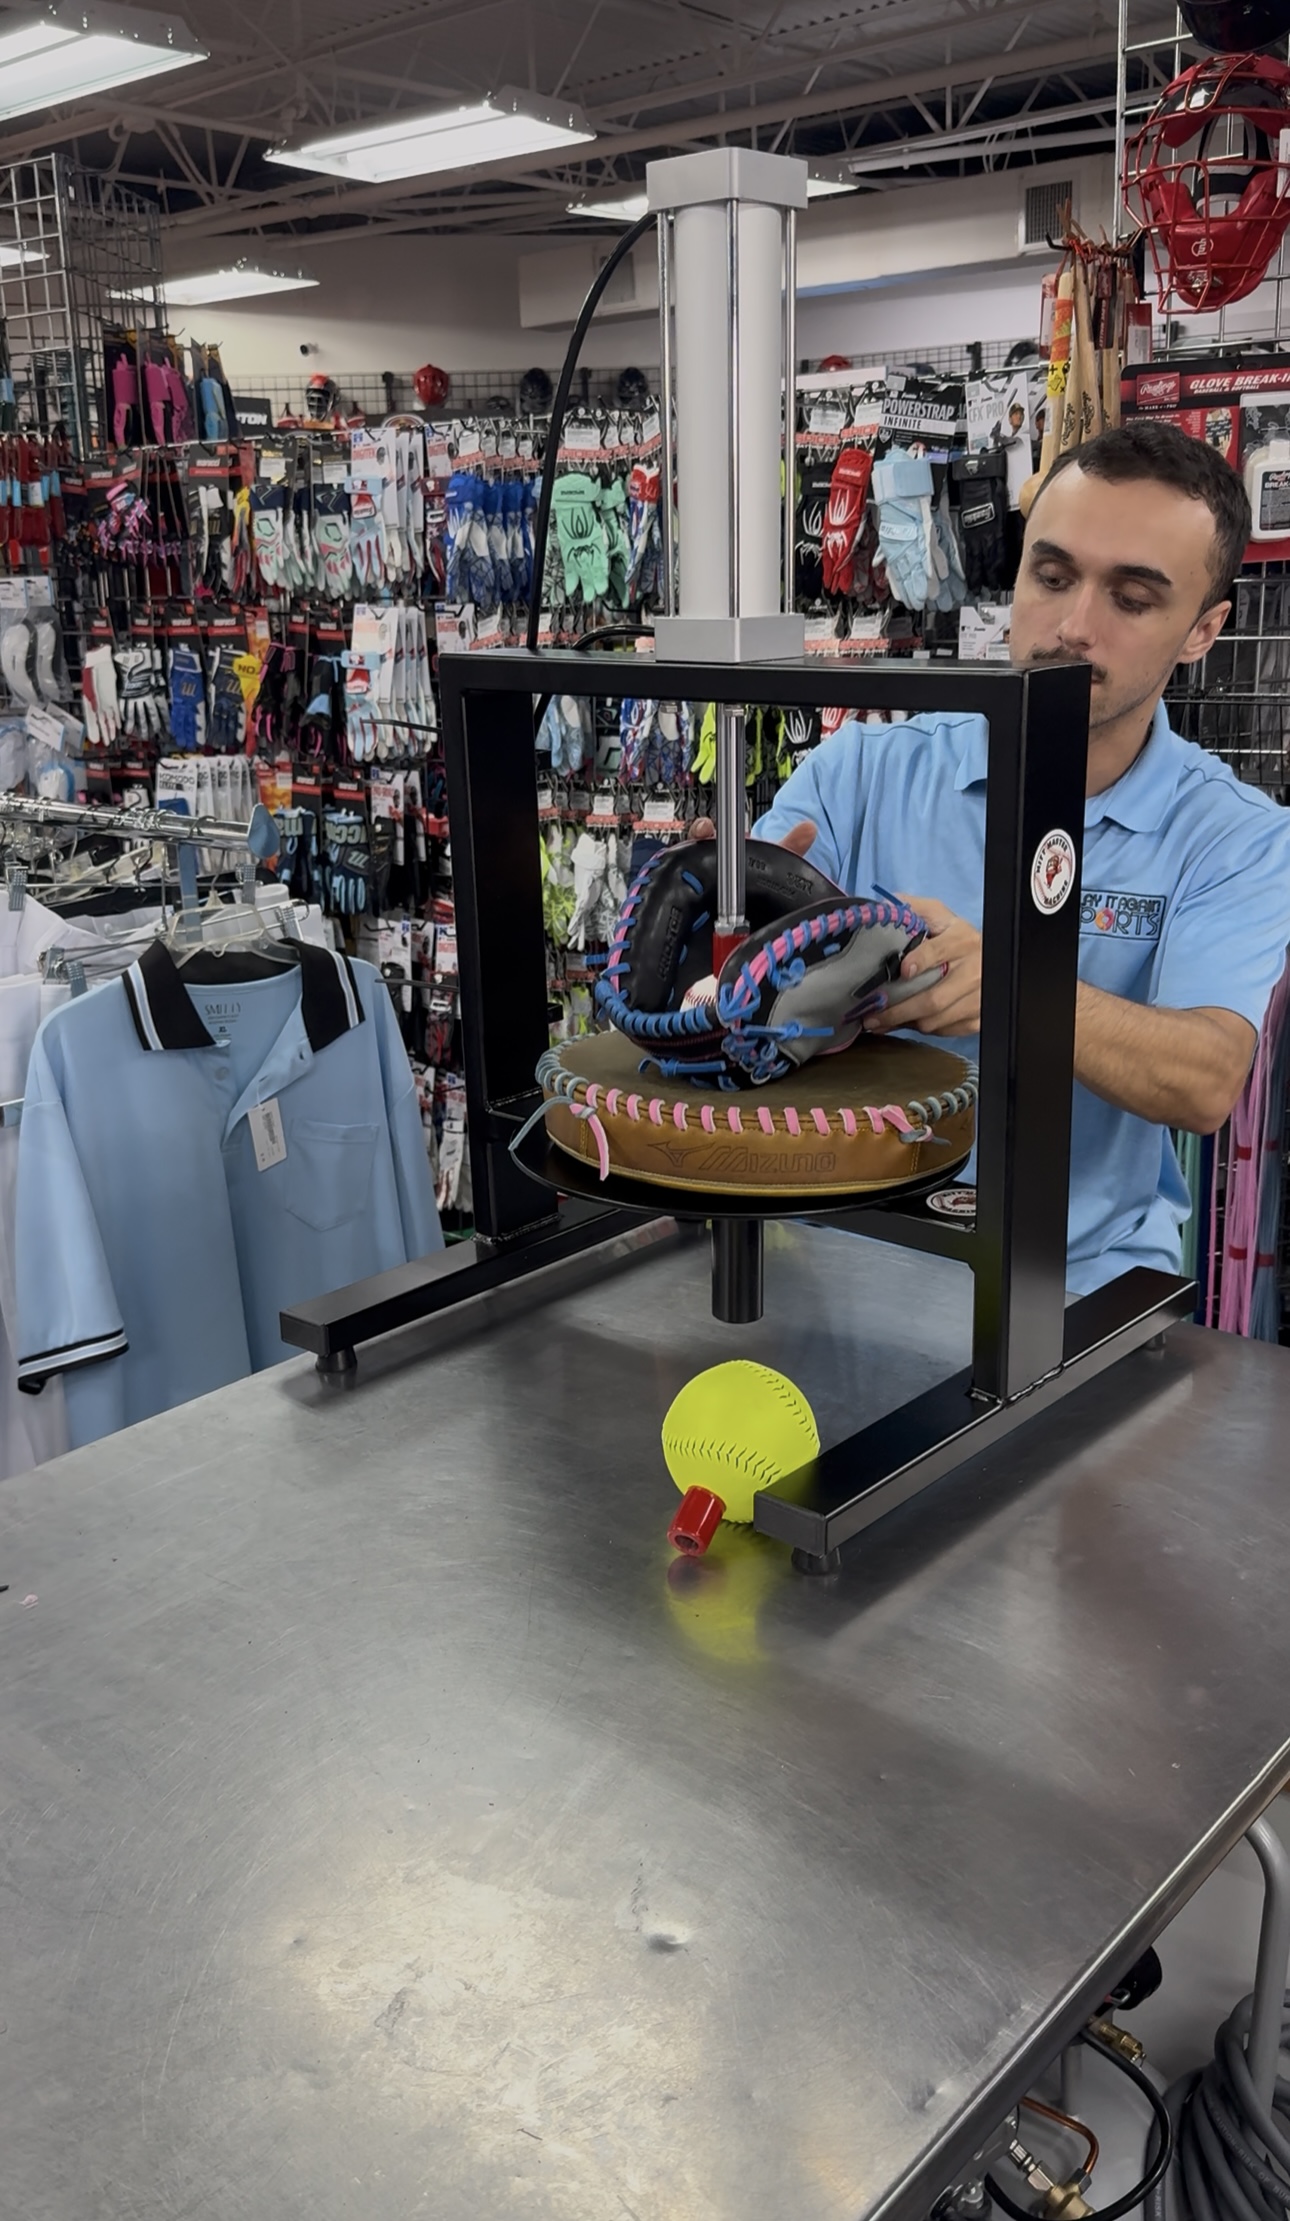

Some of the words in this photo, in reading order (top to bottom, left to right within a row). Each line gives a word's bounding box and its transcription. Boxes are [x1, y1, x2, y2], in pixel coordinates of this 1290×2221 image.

[1189, 377, 1233, 390] GLOVE
[882, 399, 955, 421] POWERSTRAP
[986, 400, 1004, 419] PRO
[883, 416, 922, 430] INFINITE
[1035, 849, 1047, 873] MITT
[1047, 837, 1069, 852] MASTER
[1043, 879, 1069, 906] MACHINE
[1080, 906, 1159, 936] PORTS
